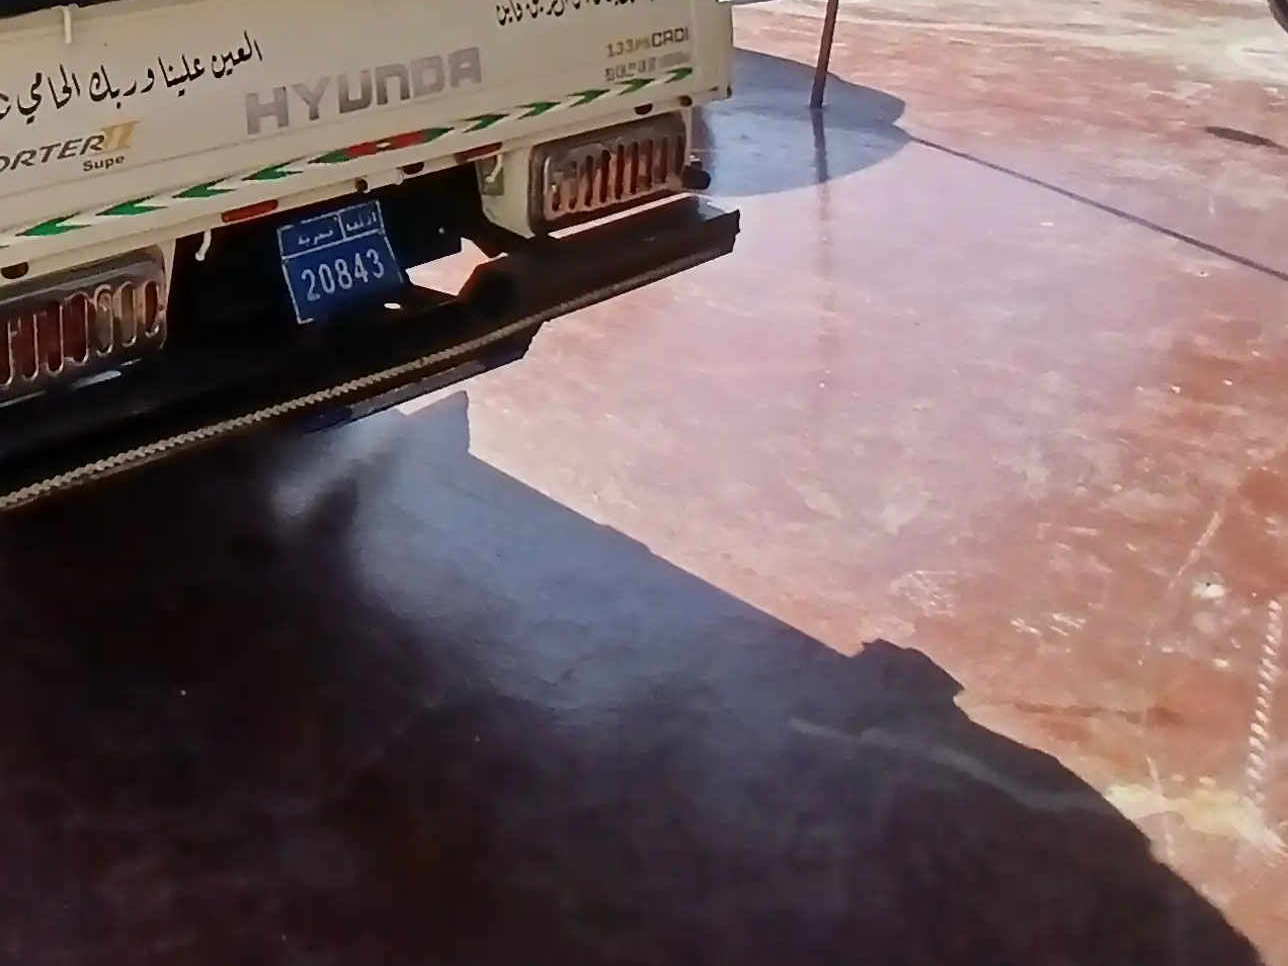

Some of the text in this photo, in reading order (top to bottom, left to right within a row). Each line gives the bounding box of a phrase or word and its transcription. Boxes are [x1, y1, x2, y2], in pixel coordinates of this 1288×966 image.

[158, 54, 206, 97] علينا
[211, 30, 264, 79] العين
[16, 63, 82, 124] الحامي
[300, 248, 385, 302] 20843
